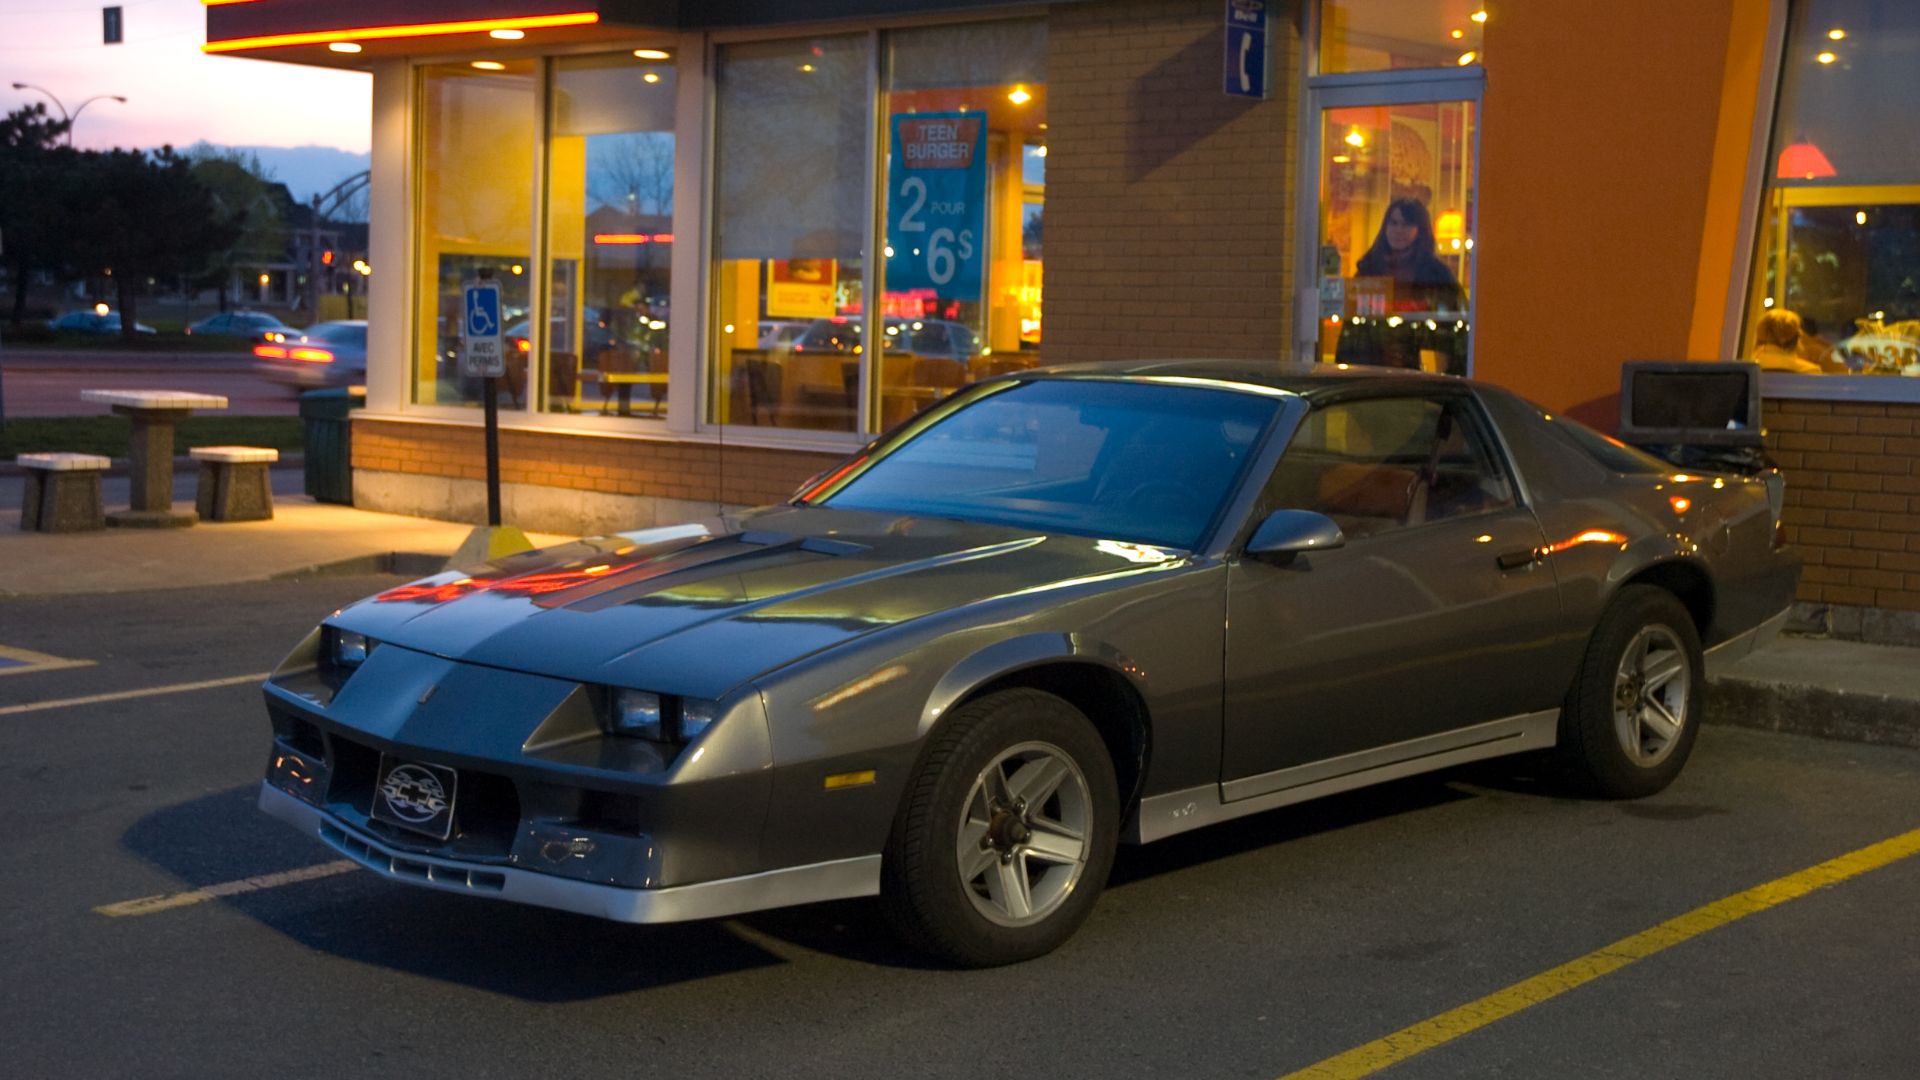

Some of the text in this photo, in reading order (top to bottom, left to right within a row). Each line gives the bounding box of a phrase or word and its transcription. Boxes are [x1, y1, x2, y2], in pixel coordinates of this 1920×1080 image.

[918, 124, 958, 141] TEEN
[906, 143, 969, 160] BURGER
[899, 176, 966, 232] 2 POUR
[473, 342, 496, 354] AVEC
[469, 355, 500, 367] PERMIS
